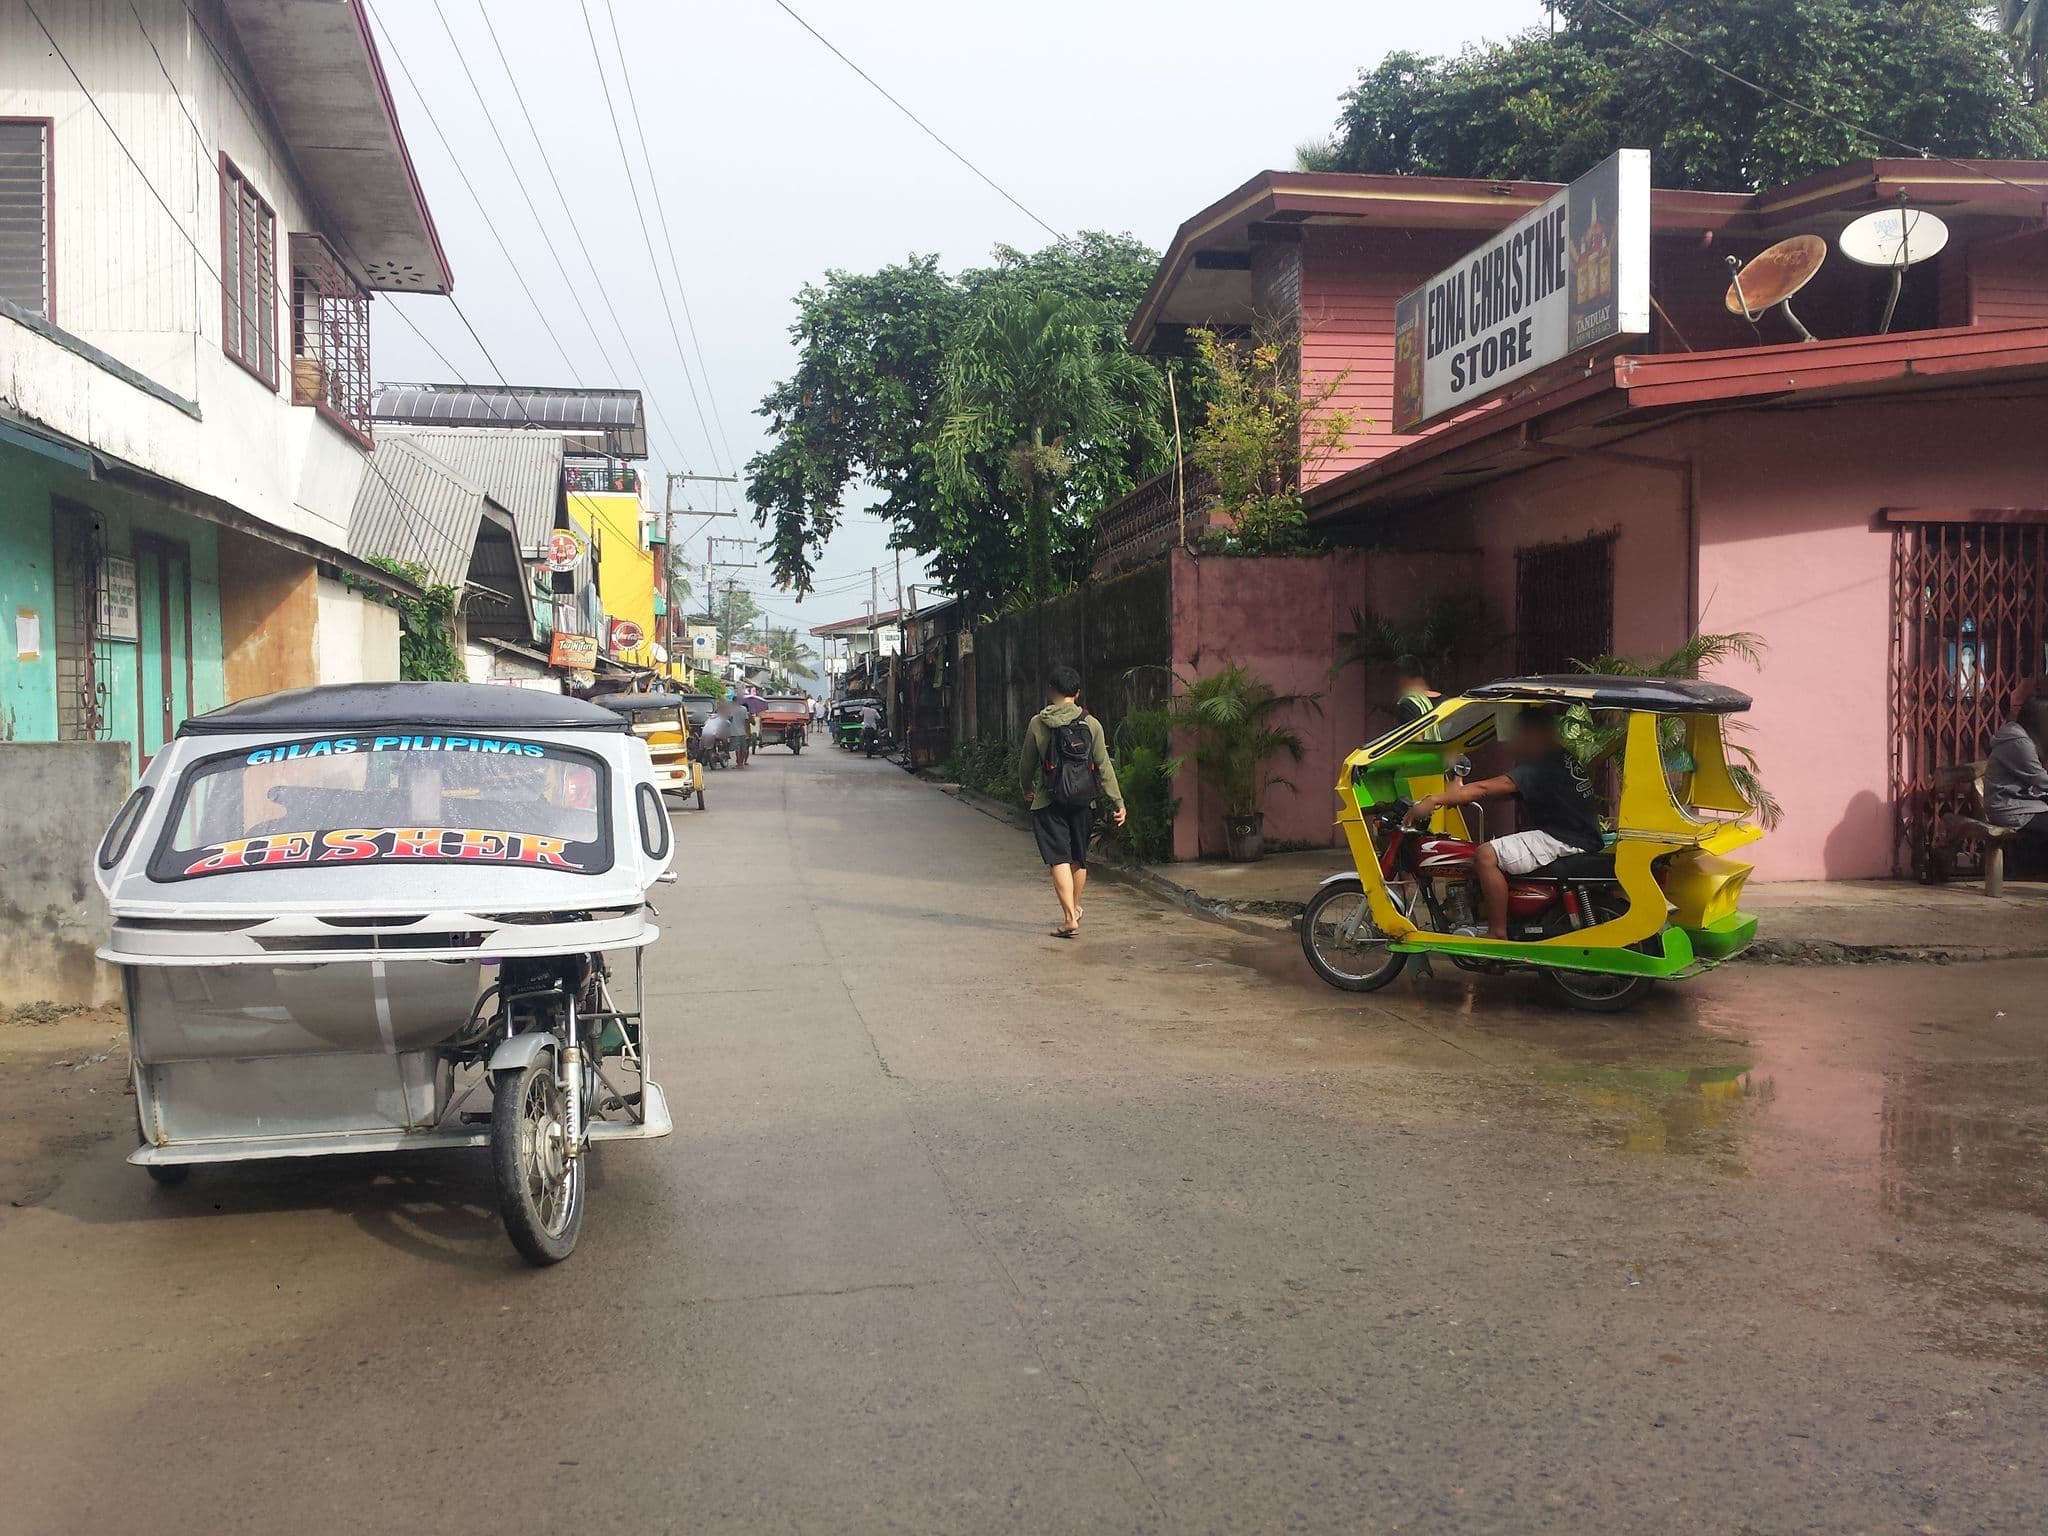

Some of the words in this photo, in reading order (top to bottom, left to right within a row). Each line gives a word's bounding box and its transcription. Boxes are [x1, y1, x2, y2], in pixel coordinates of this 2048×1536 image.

[1427, 269, 1466, 360] EDNA
[1469, 203, 1566, 338] CHRISTINE
[1576, 304, 1611, 335] TANDUAY
[1450, 317, 1533, 393] STORE
[183, 828, 584, 875] JESHER
